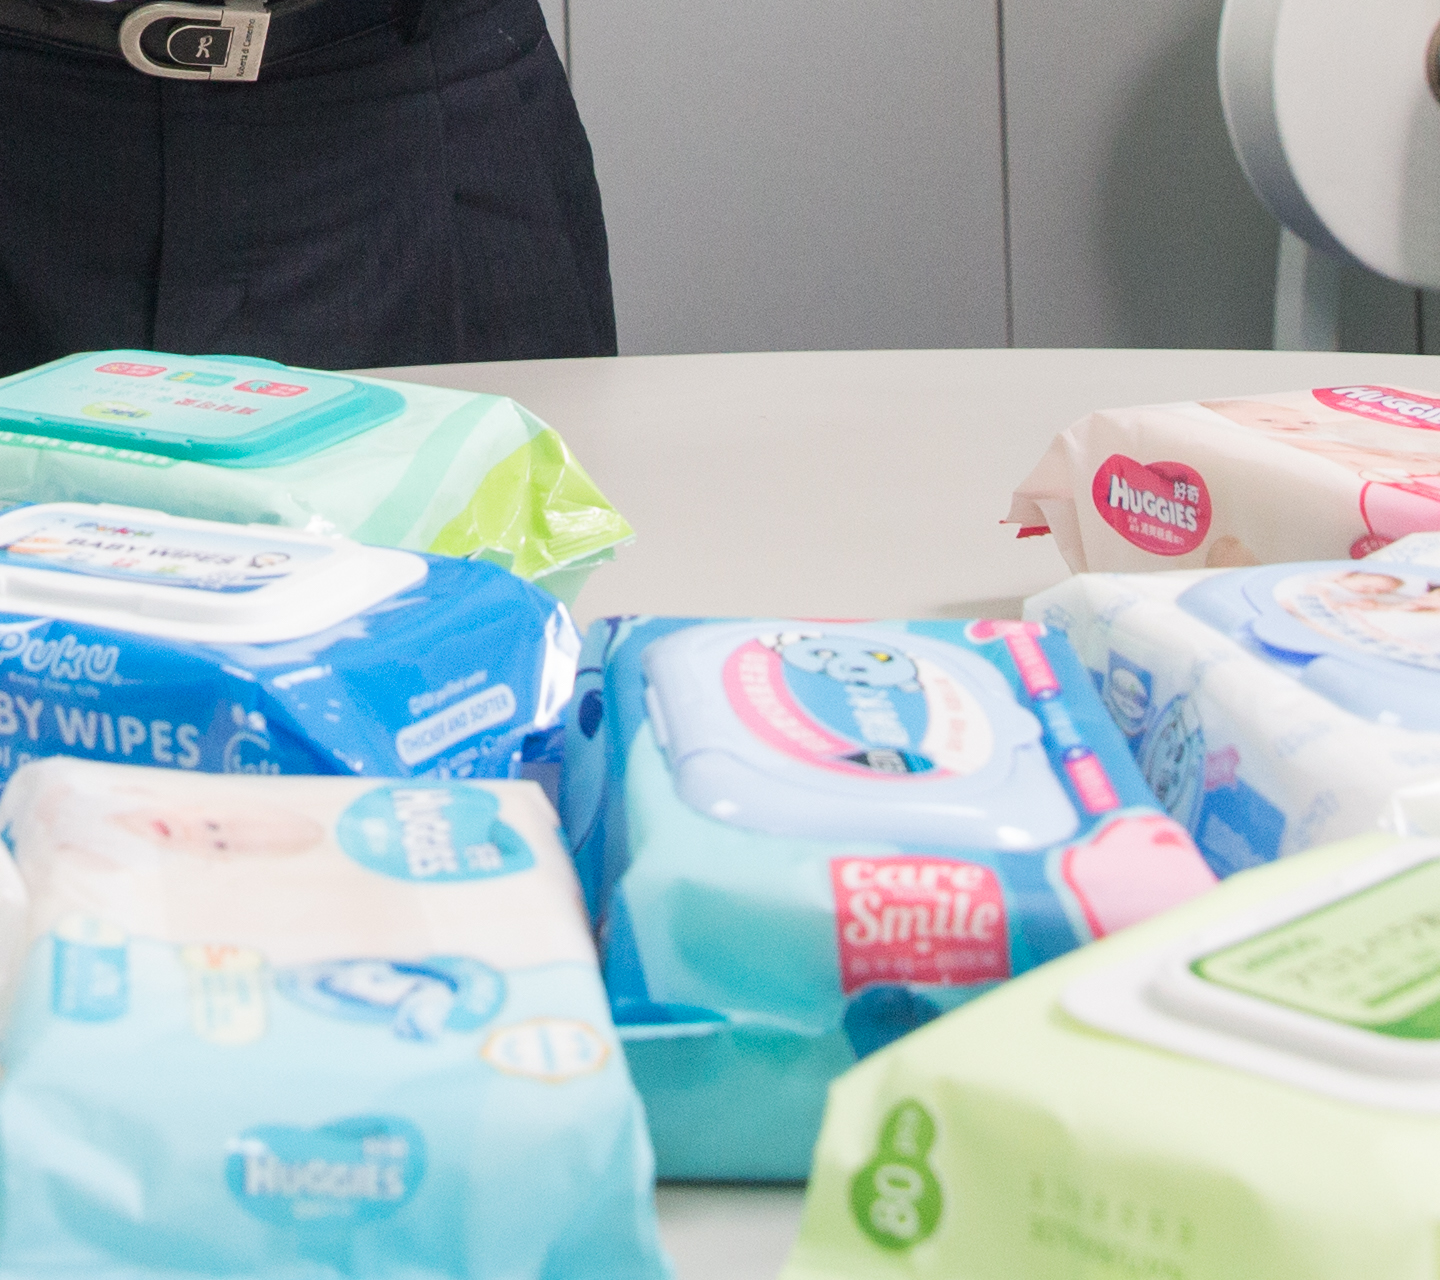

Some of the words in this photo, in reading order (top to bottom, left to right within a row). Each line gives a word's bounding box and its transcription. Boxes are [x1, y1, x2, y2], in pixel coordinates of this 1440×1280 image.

[1107, 473, 1199, 533] HUGGIES
[66, 537, 142, 553] BABY
[148, 546, 240, 565] WIPES
[54, 704, 201, 769] WIPES
[447, 710, 469, 733] AND
[839, 859, 988, 895] care
[842, 893, 1003, 948] Smile
[244, 1155, 407, 1199] HUGGIES
[868, 1163, 926, 1239] 80
